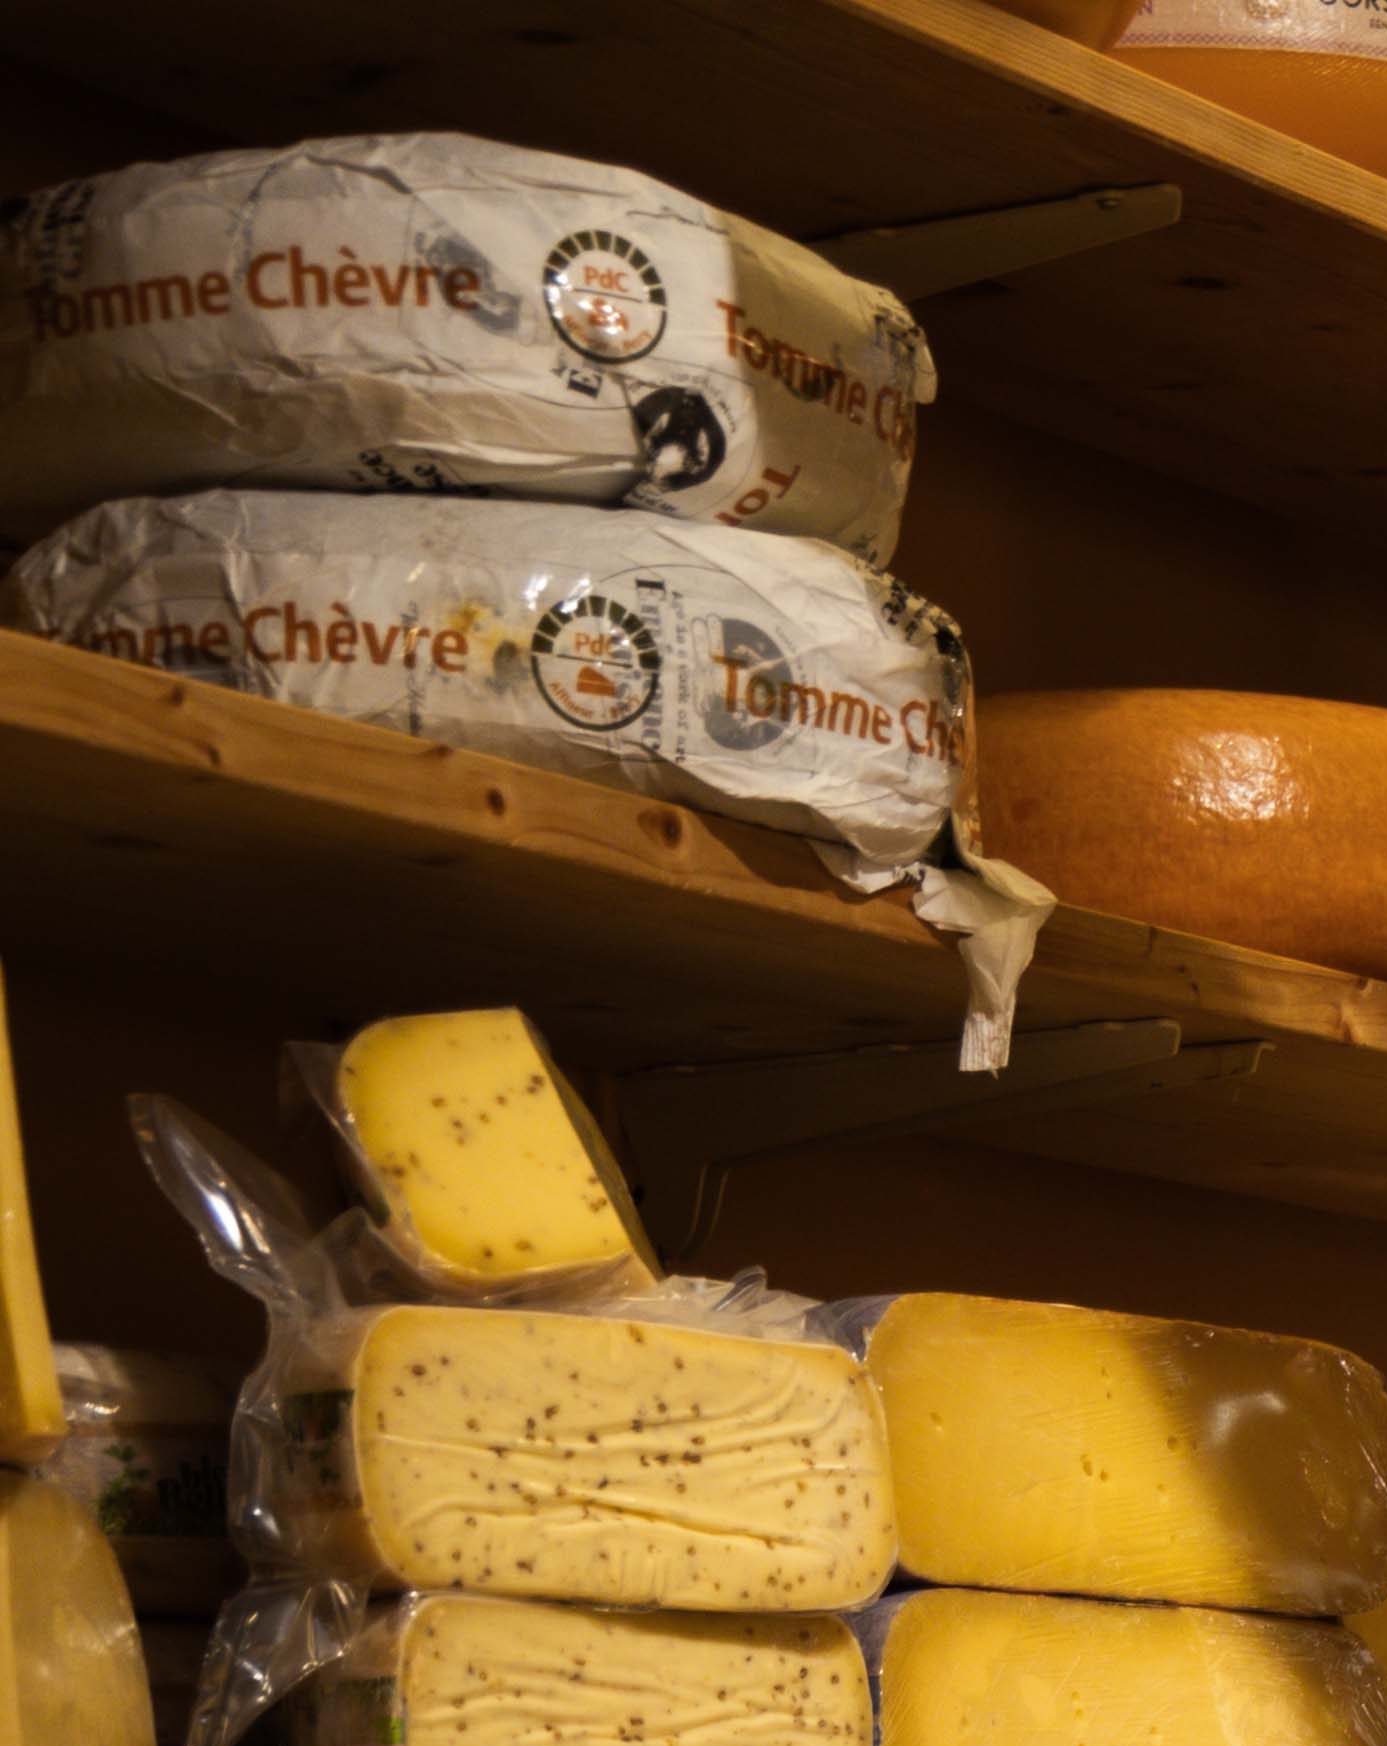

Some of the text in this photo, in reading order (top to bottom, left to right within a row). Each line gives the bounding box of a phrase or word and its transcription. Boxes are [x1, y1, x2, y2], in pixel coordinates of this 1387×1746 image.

[245, 245, 482, 315] Chèvre
[584, 266, 630, 293] PdC
[716, 299, 868, 425] Tomme
[244, 602, 469, 672] Chèvre
[713, 654, 893, 744] Tomme
